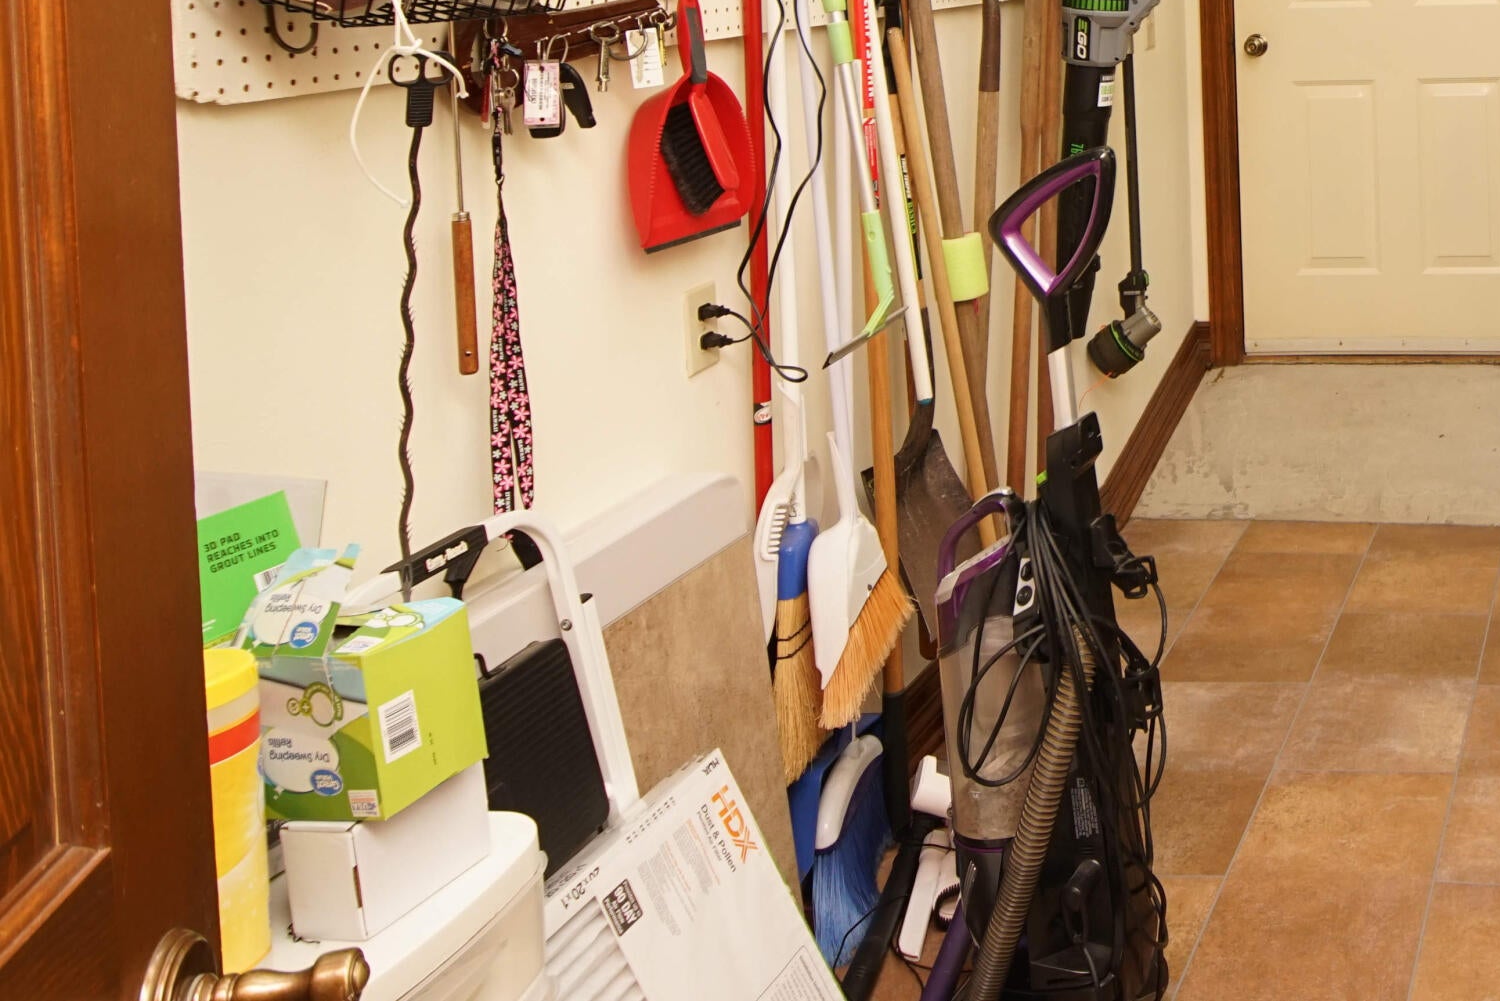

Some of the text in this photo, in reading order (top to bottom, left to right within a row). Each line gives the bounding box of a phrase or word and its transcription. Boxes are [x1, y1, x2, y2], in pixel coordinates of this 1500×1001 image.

[1076, 18, 1087, 59] EGO
[203, 532, 241, 552] 3D PAD
[207, 529, 280, 563] REACHES INTO
[209, 541, 277, 574] GROUT LINES
[308, 603, 323, 614] Dry
[267, 738, 292, 748] Refills
[269, 750, 330, 762] Dry Sweeping
[700, 803, 714, 826] Dust
[717, 838, 737, 873] Pollen
[711, 785, 758, 864] HDX
[622, 902, 638, 925] DAY
